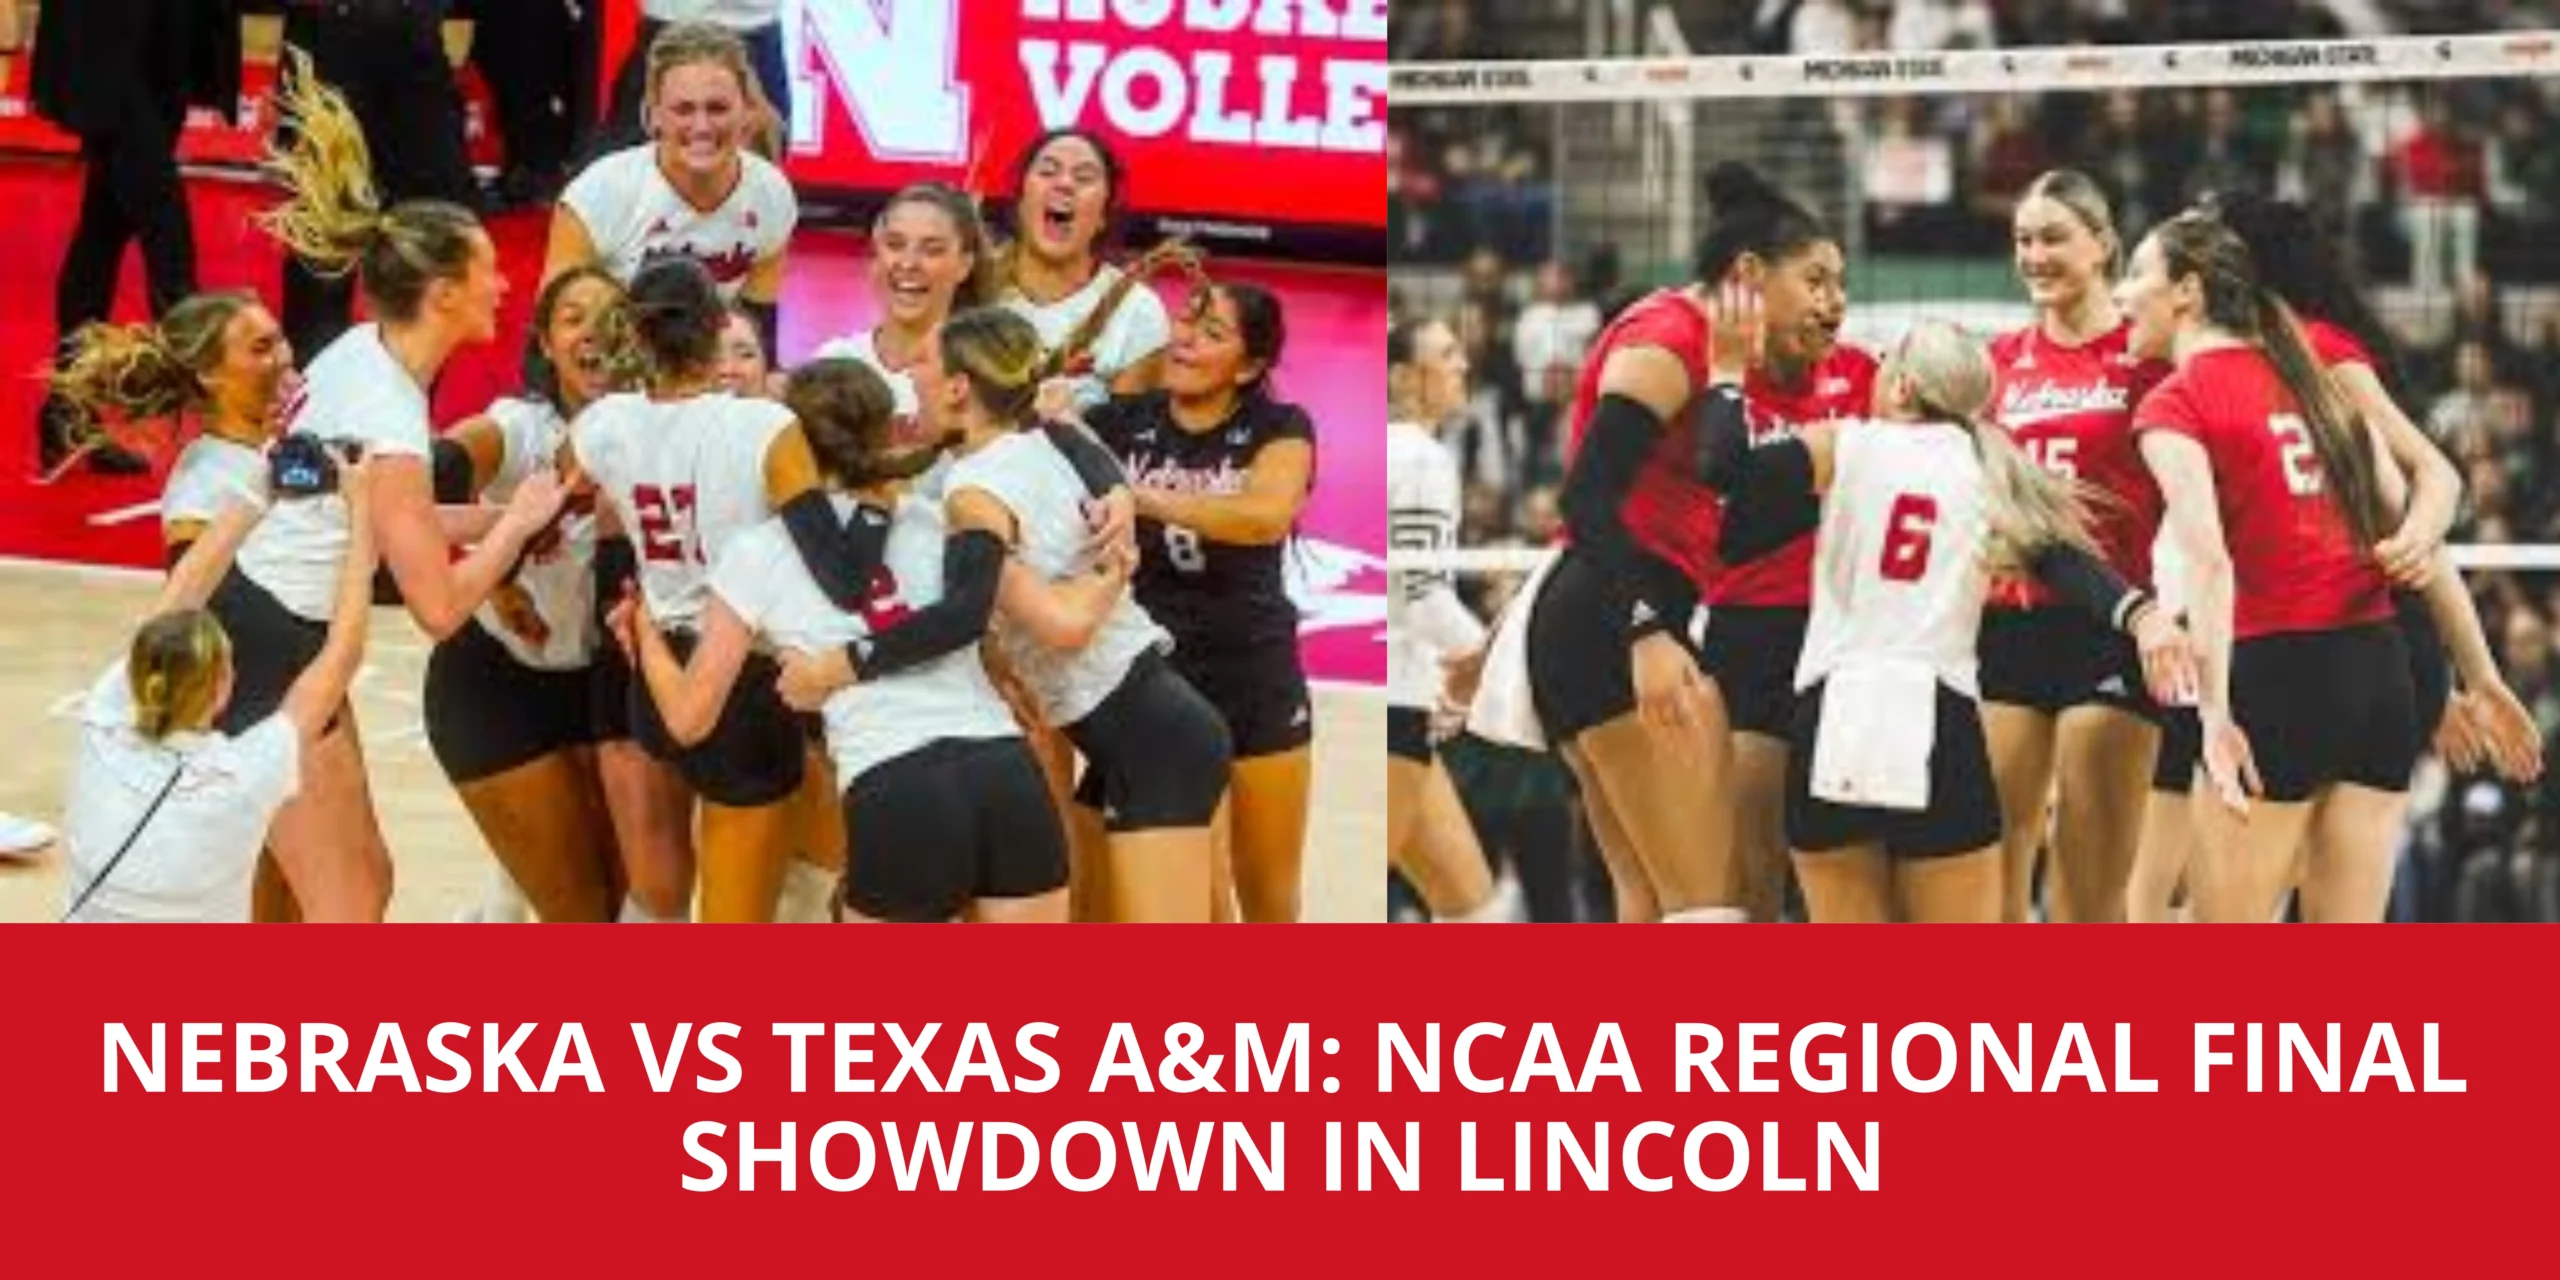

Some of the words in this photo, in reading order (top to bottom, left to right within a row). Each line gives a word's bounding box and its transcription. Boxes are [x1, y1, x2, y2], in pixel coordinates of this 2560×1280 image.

[2001, 377, 2129, 418] Nebraska
[1163, 523, 1207, 571] 8
[1879, 494, 1938, 582] 6
